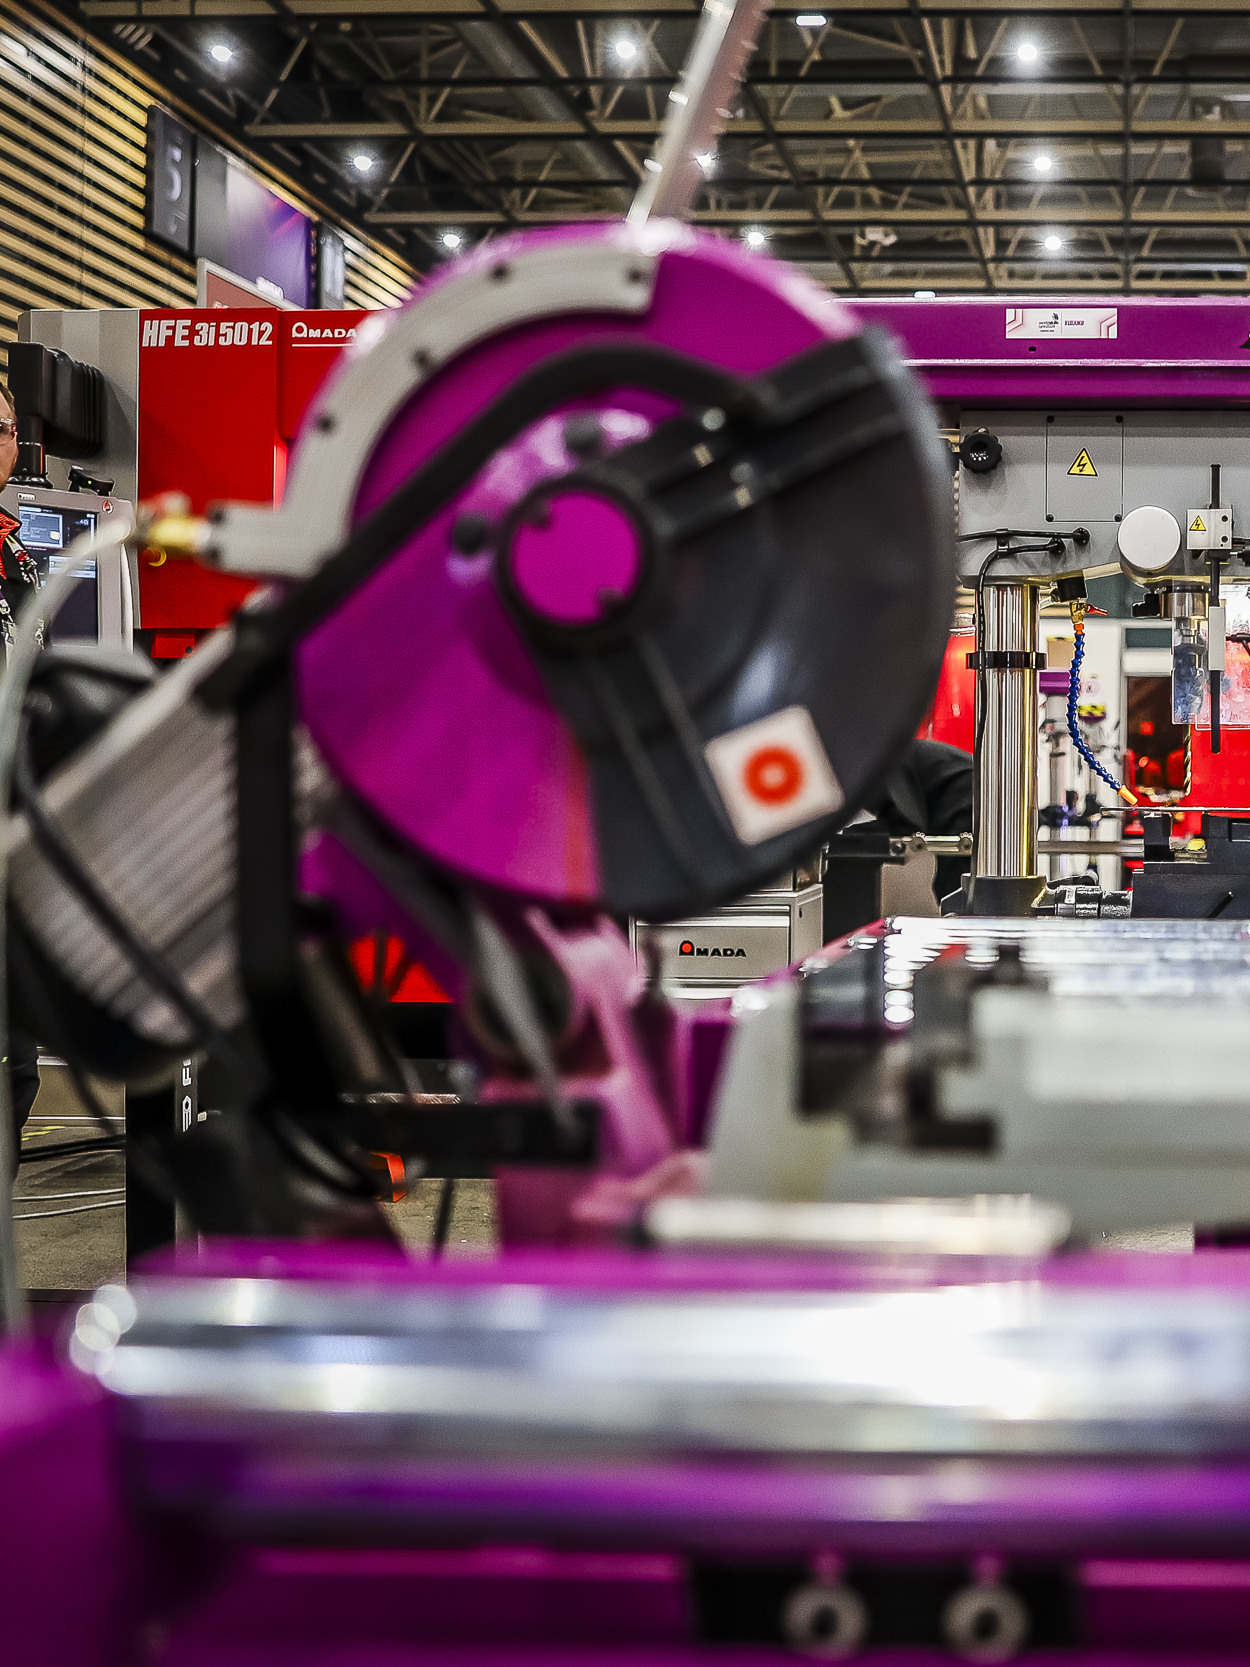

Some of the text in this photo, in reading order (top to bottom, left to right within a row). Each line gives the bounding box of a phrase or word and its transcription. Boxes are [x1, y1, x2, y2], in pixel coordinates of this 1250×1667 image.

[142, 319, 192, 347] HFE
[291, 322, 358, 339] AMADA
[678, 940, 747, 958] AMADA
